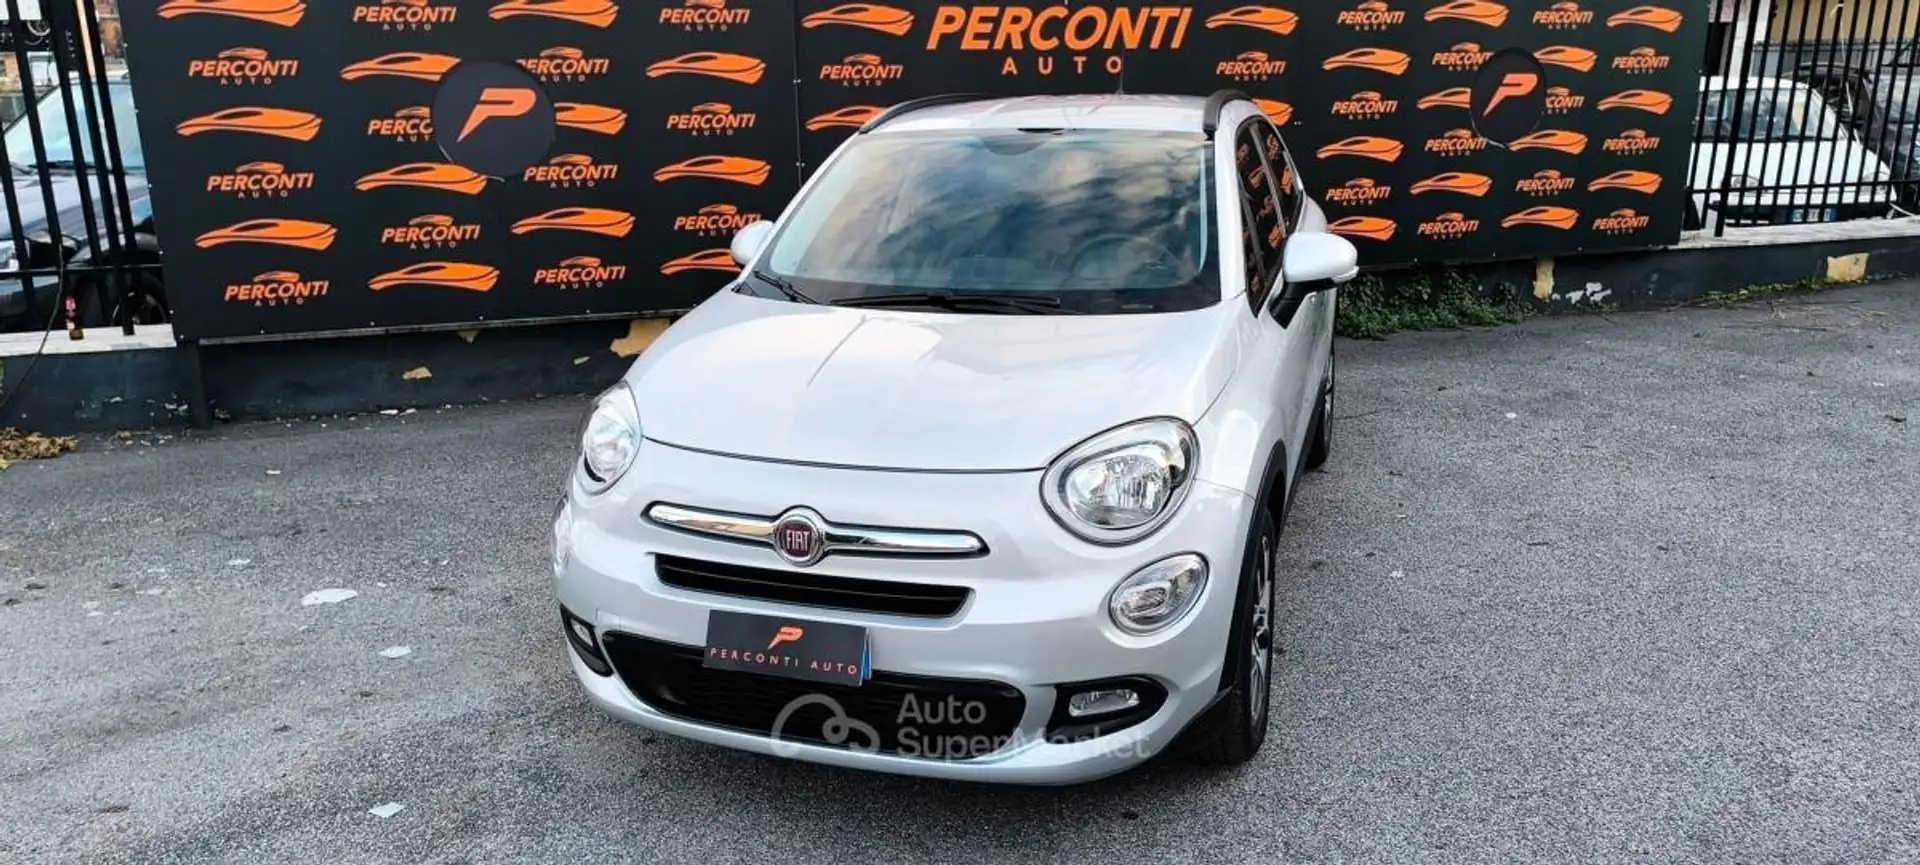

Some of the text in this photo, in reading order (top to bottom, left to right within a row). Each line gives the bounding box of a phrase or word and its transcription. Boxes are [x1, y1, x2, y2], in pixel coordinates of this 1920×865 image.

[352, 5, 457, 24] PERCONTI
[659, 7, 751, 25] PERCONTI
[1337, 10, 1404, 25] PERCONTI
[1532, 10, 1593, 25] PERCONTI
[383, 23, 432, 31] AUTO
[685, 23, 727, 32] AUTO
[926, 5, 1192, 52] PERCONTI
[188, 59, 299, 78] PERCONTI
[1001, 55, 1124, 77] AUTO
[1215, 60, 1284, 77] PERCONTI
[1612, 55, 1668, 69] PERCONTI
[541, 75, 585, 83] AUTO
[818, 63, 904, 81] PERCONTI
[221, 77, 272, 86] AUTO
[843, 79, 882, 88] AUTO
[1331, 100, 1397, 115] PERCONTI
[1545, 95, 1583, 108] CONTI
[367, 118, 434, 137] PERCO
[666, 112, 757, 130] PERCONTI
[396, 135, 431, 143] AUT
[692, 129, 734, 137] AUTO
[1424, 137, 1487, 152] PERCONTI
[1602, 136, 1659, 151] PERCONTI
[523, 163, 618, 183] PERCONTI
[206, 172, 316, 193] PERCONTI
[551, 180, 595, 189] AUTO
[1515, 176, 1574, 191] PERCONTI
[239, 190, 288, 199] AUTO
[1326, 186, 1390, 201] PERCONTI
[1417, 220, 1479, 236] PERCONTI
[1592, 215, 1649, 230] PERCONTI
[381, 224, 482, 244] PERCONTI
[410, 240, 456, 250] AUTO
[534, 265, 626, 284] PERCONTI
[223, 280, 331, 302] PERCONTI
[560, 281, 603, 290] AUTO
[255, 298, 304, 307] AUTO
[785, 529, 810, 551] FIAT
[710, 647, 858, 675] PERCONTI AUTO
